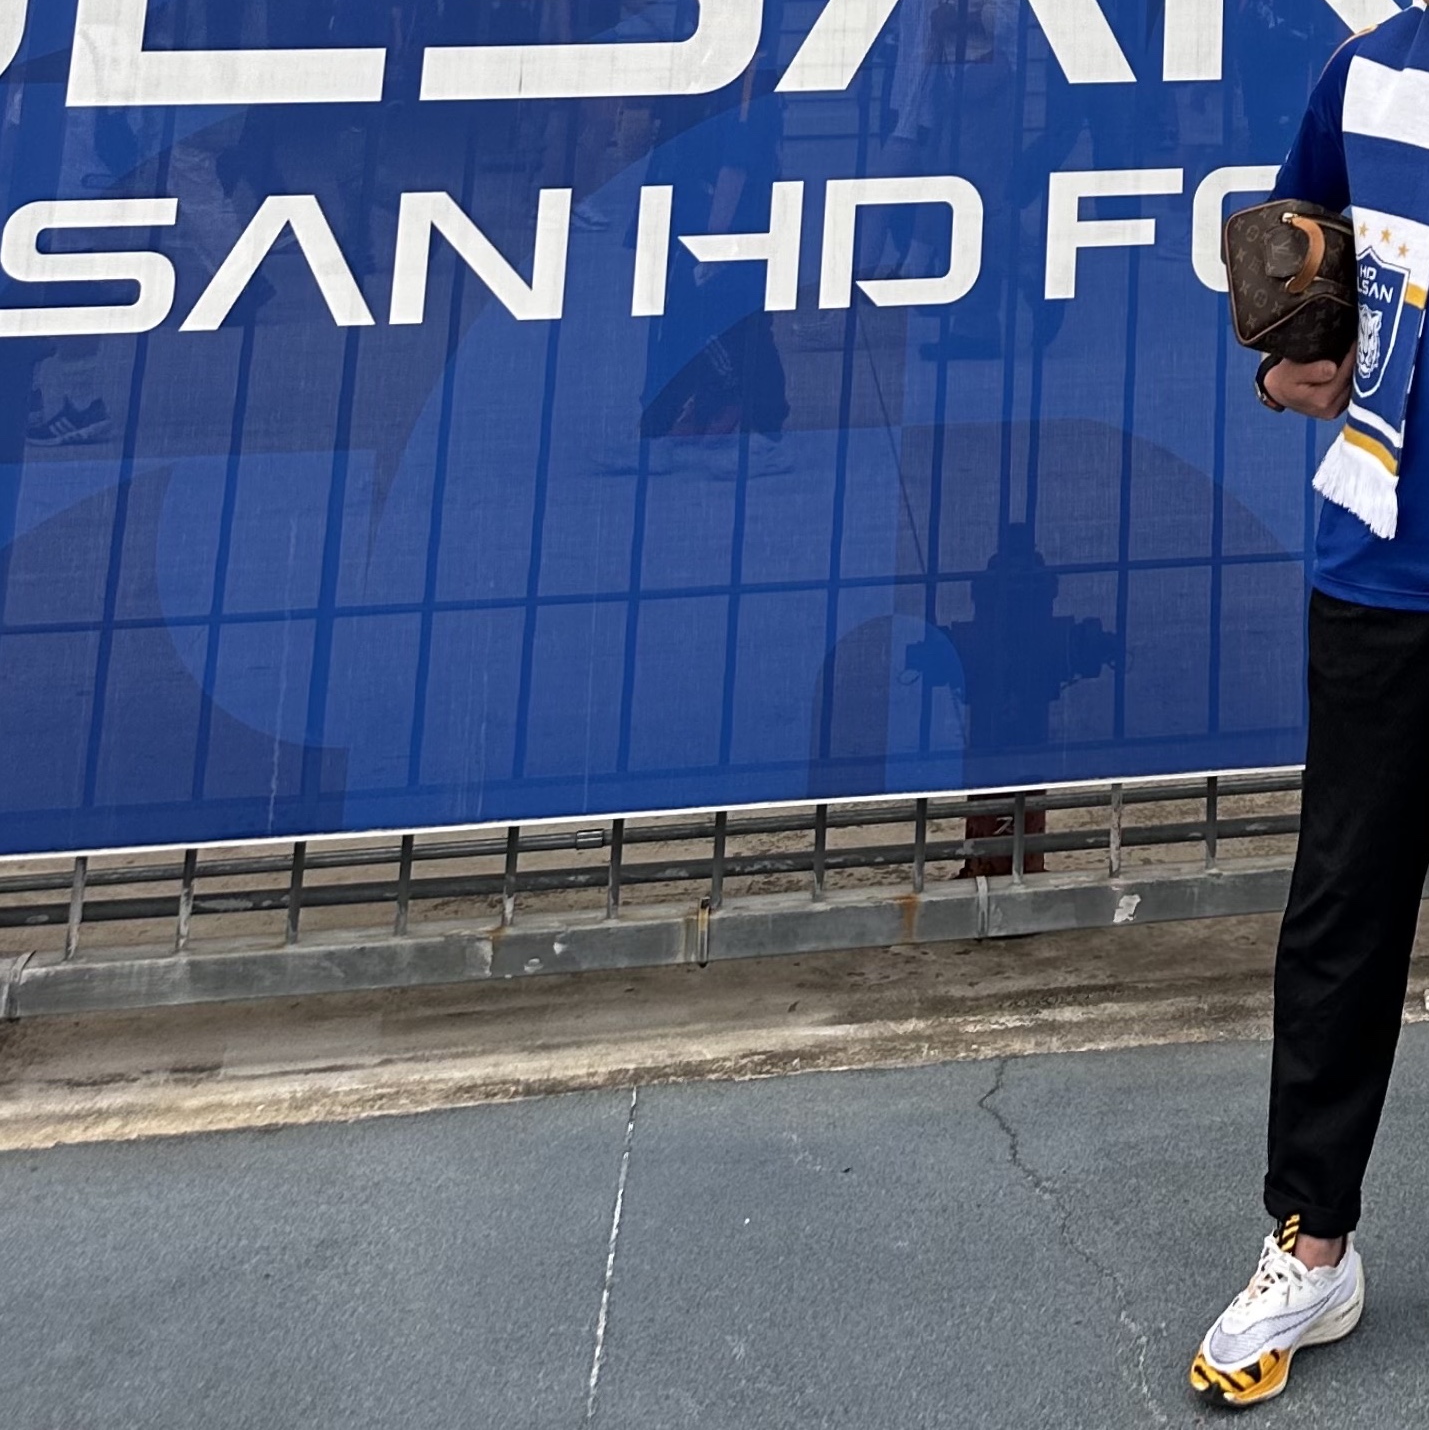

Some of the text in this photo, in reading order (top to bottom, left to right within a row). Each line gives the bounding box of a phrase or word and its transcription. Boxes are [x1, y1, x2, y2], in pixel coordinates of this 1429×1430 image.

[631, 175, 984, 317] HD
[1360, 264, 1377, 280] HD
[1357, 276, 1394, 303] LSAN
